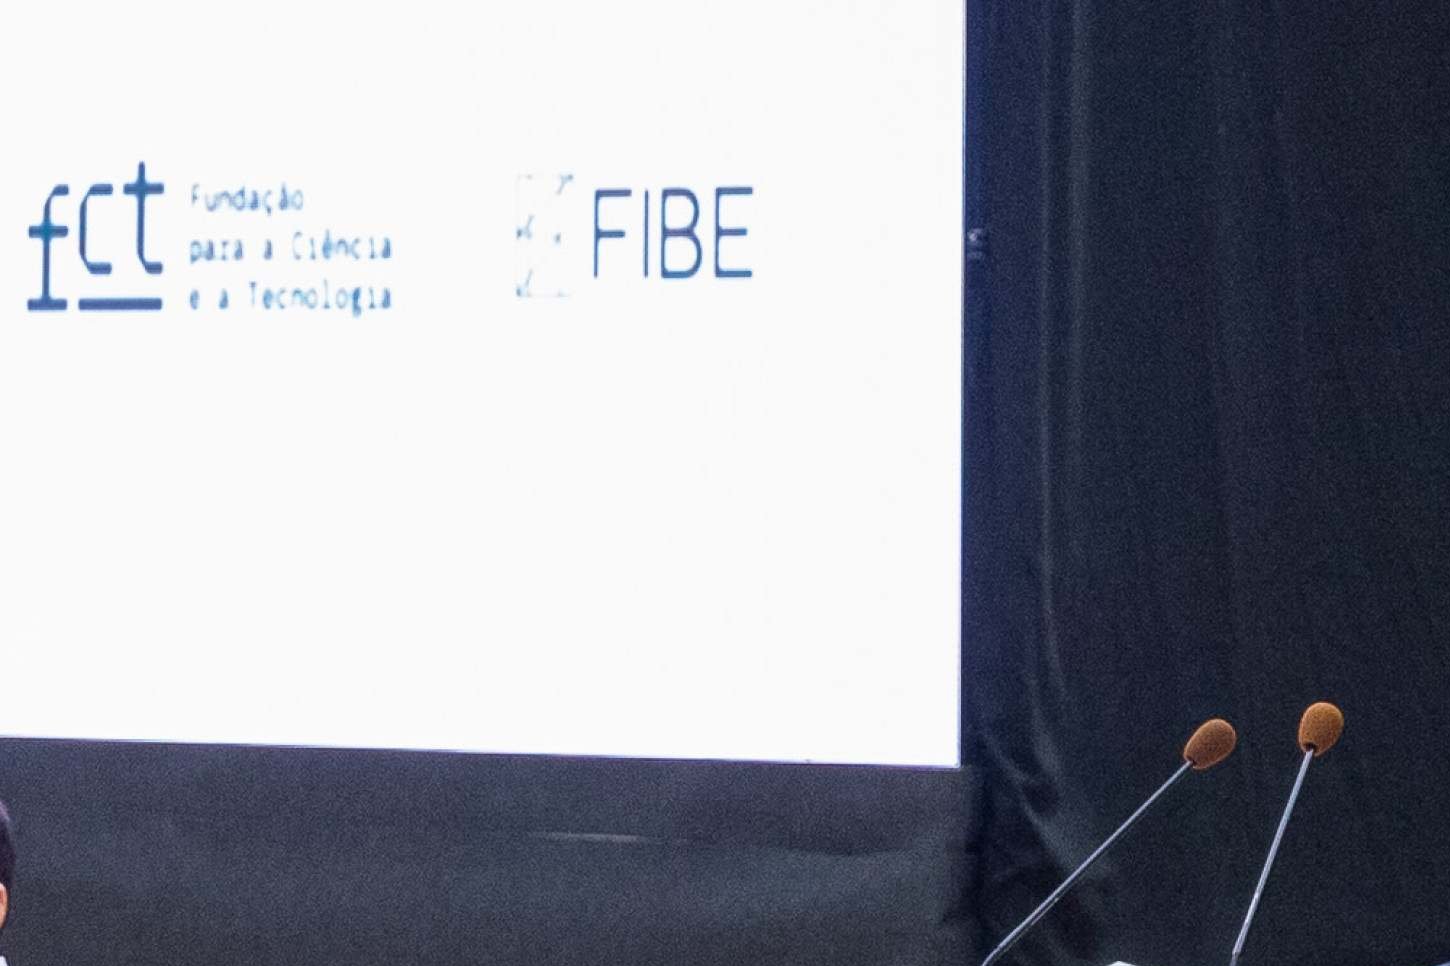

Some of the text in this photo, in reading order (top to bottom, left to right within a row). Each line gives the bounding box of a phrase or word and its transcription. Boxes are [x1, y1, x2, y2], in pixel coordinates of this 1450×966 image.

[190, 182, 305, 215] Fundação
[27, 160, 165, 311] fct
[190, 229, 392, 264] para a Ciência
[594, 186, 754, 279] FIBE
[189, 279, 392, 317] e a Tecnologia
